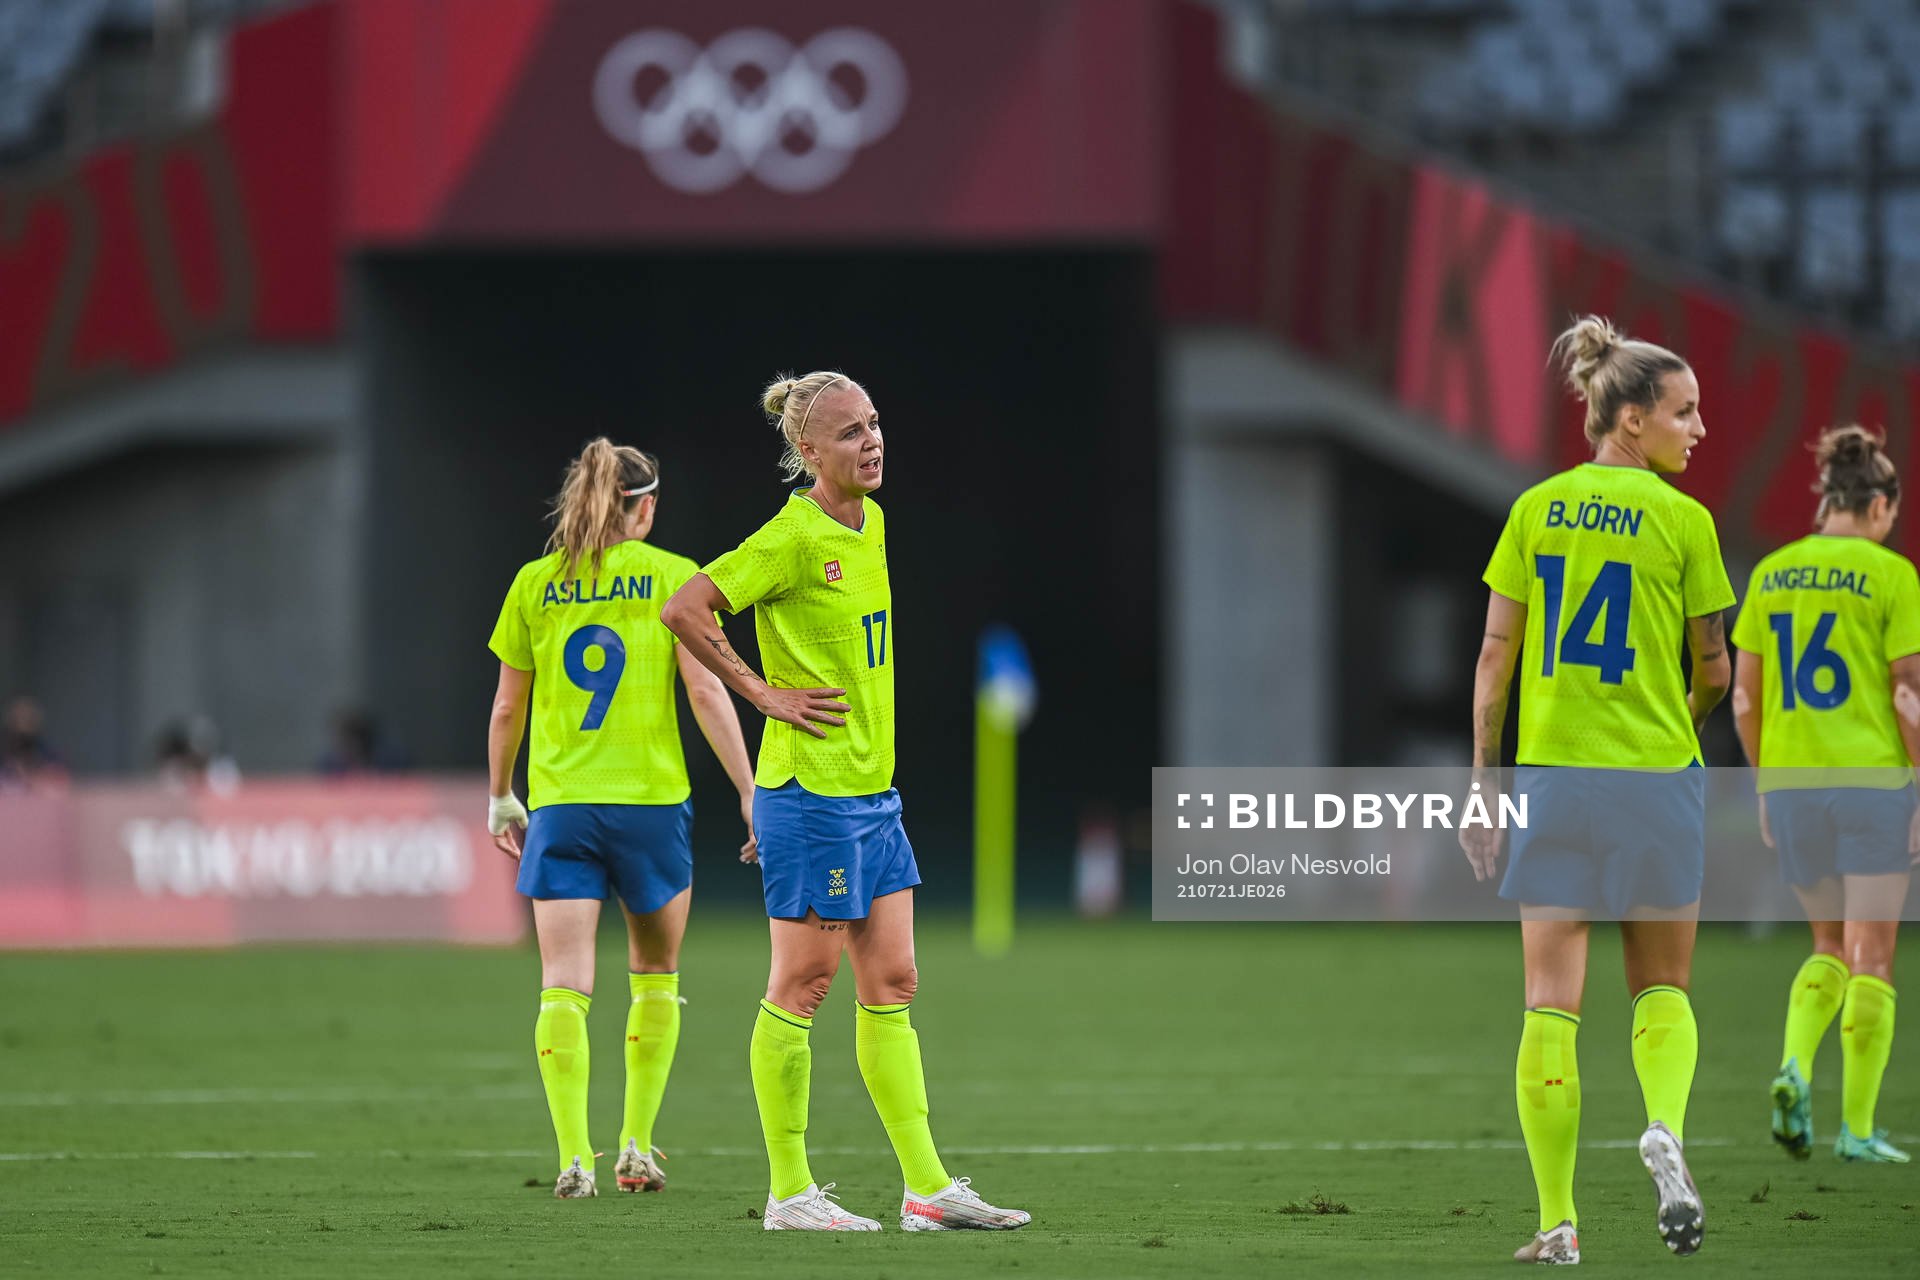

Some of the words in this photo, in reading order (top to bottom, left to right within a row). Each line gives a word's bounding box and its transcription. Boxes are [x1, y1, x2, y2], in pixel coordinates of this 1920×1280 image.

[1546, 495, 1644, 537] BJÖRN
[825, 562, 838, 572] UNI
[827, 570, 841, 581] QLO
[1761, 566, 1873, 599] ANGELDAL
[542, 575, 653, 608] ASLLANI
[1534, 554, 1636, 686] 14
[861, 609, 887, 669] 17
[563, 624, 626, 732] 9
[1768, 612, 1852, 712] 16
[828, 886, 848, 897] SWE
